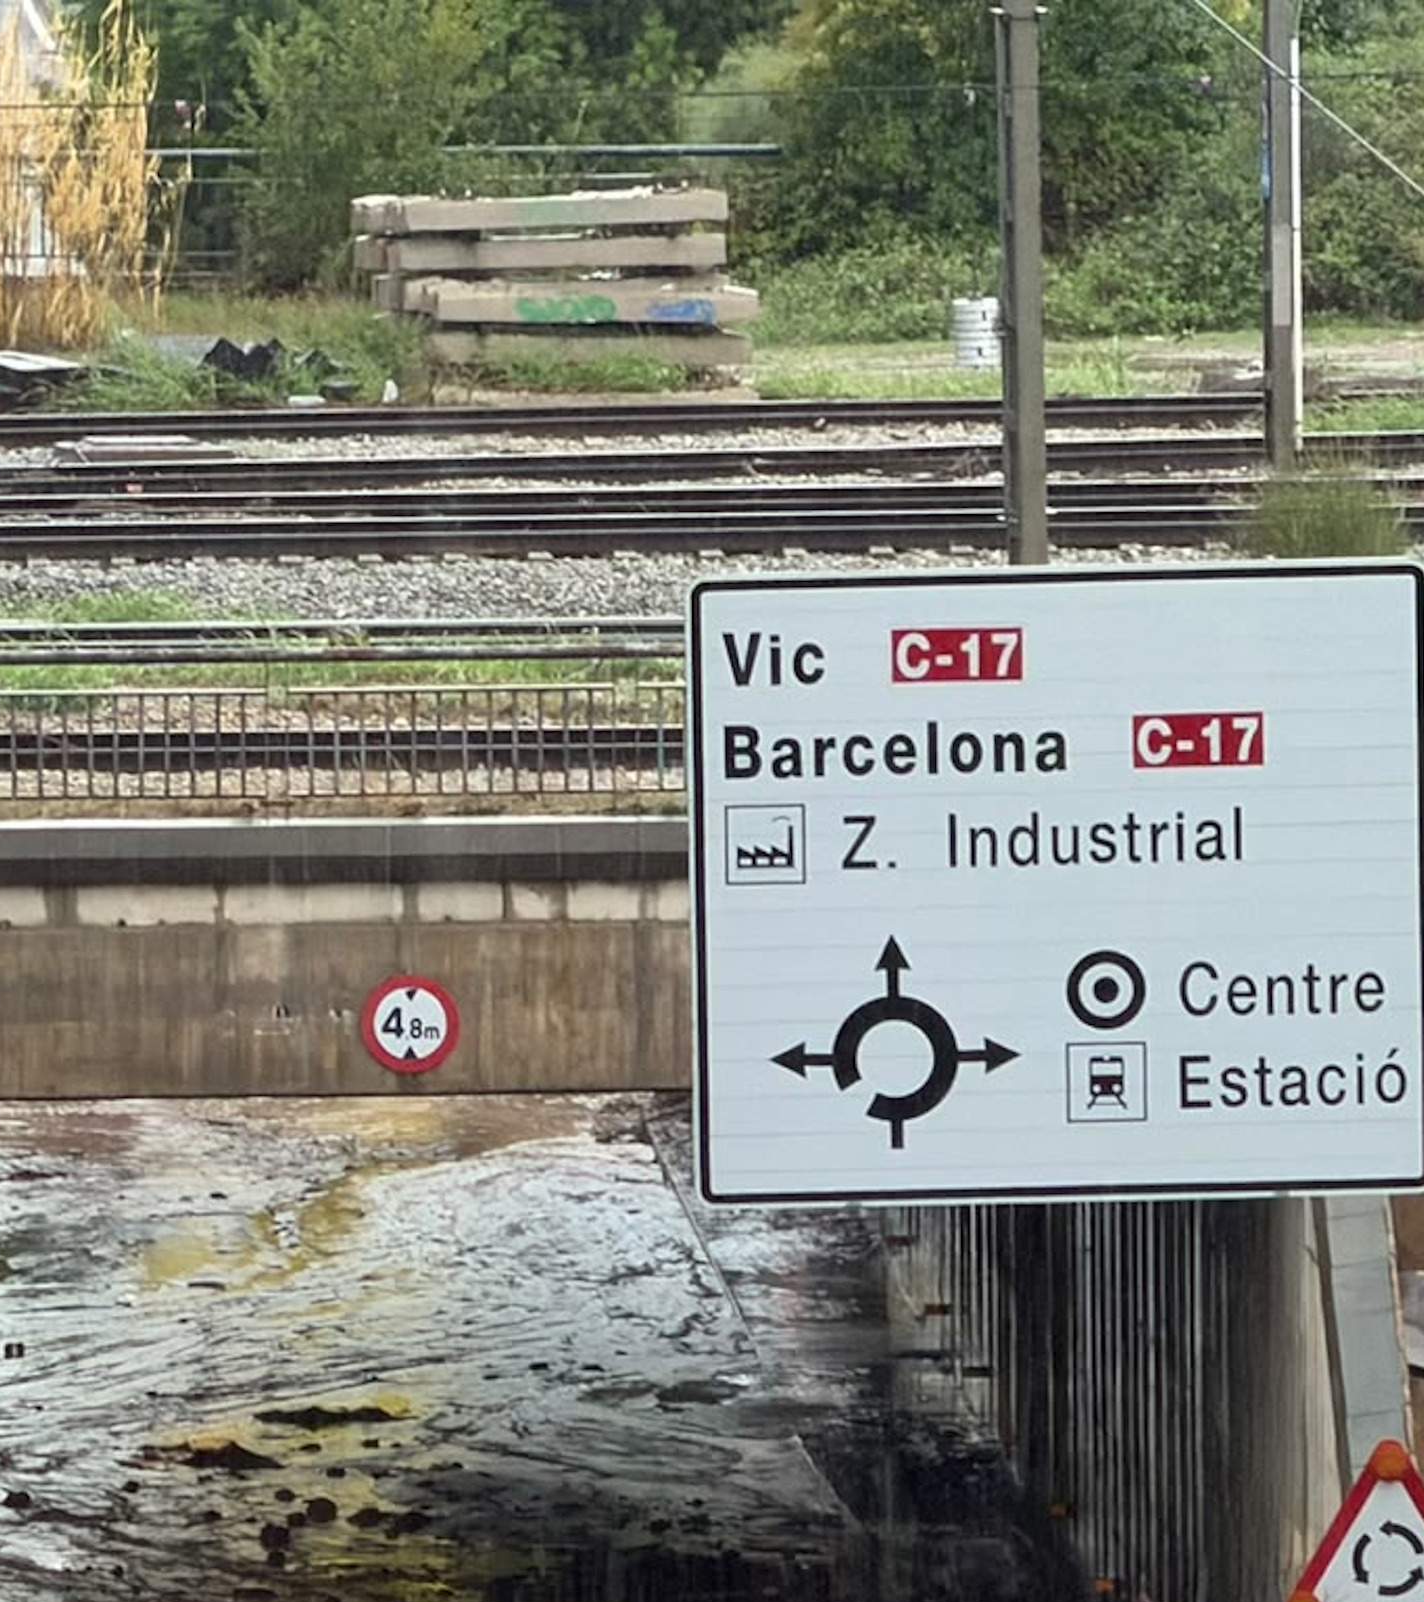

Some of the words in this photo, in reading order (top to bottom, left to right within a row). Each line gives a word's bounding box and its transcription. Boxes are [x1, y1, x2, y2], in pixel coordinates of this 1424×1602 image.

[723, 632, 826, 686] Vic
[896, 632, 1019, 679] C-17
[724, 720, 1069, 779] Barcelona
[1138, 716, 1260, 765] C-17
[842, 815, 898, 870] Z.
[948, 807, 1245, 868] Industrial
[1179, 960, 1387, 1017] Centre
[1179, 1048, 1408, 1111] Estació
